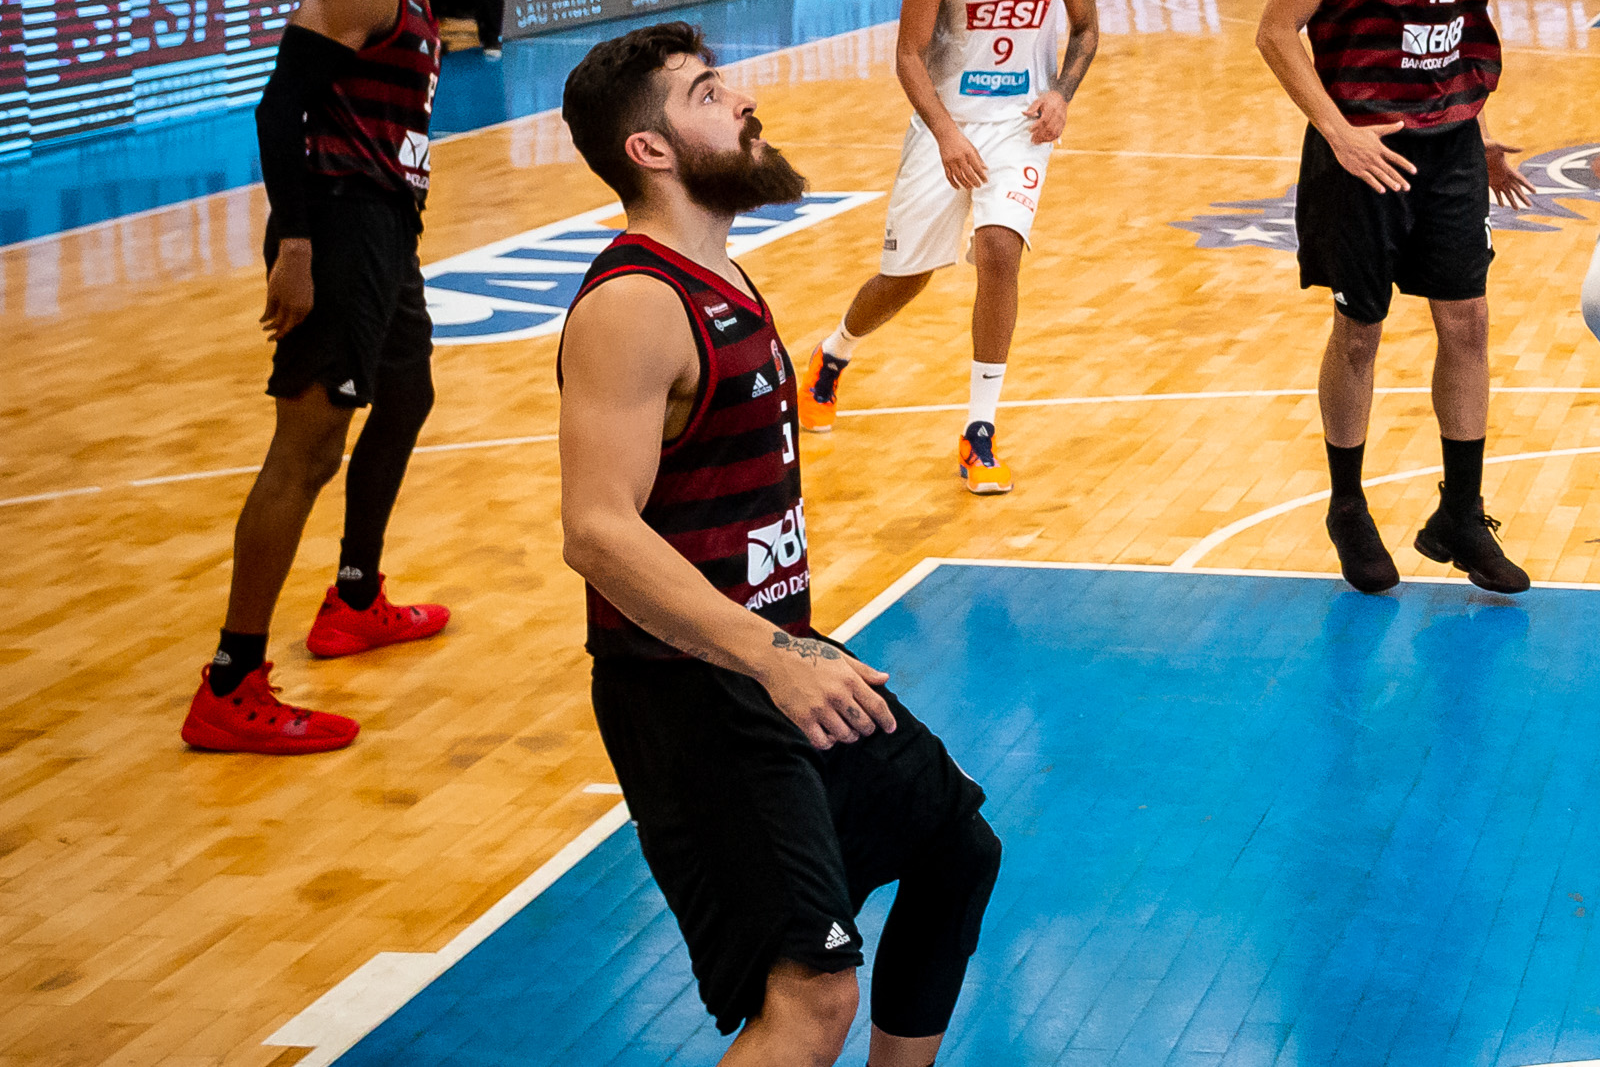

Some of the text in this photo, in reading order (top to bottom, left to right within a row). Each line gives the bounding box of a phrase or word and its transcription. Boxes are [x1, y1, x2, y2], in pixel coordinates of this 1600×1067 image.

[973, 0, 1044, 28] SESI
[992, 36, 1015, 66] 9
[1022, 166, 1040, 190] 9
